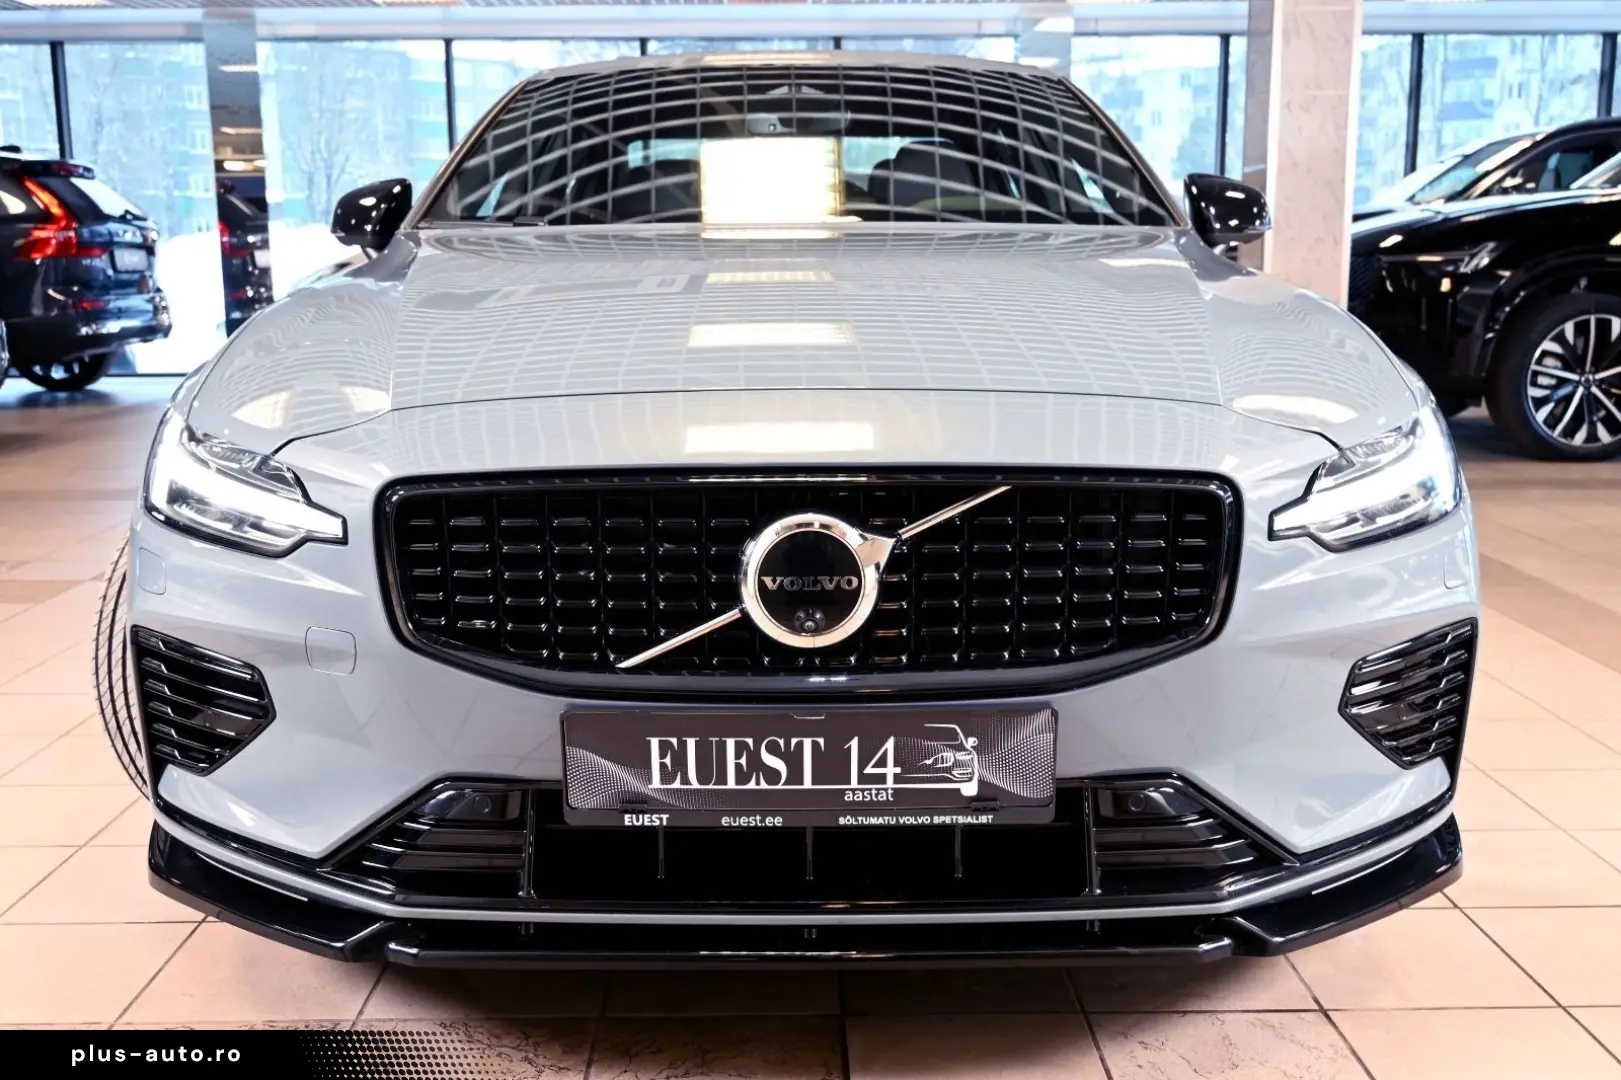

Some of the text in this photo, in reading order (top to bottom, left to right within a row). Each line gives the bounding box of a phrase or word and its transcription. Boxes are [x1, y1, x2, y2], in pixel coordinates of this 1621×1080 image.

[760, 575, 859, 592] VOLVO
[646, 735, 902, 789] EUEST 14
[843, 788, 895, 802] aastat
[623, 813, 670, 826] EUEST
[720, 814, 783, 827] euest.ee
[838, 814, 994, 825] SÕLTUMATU VOLVO SPETSIALIST
